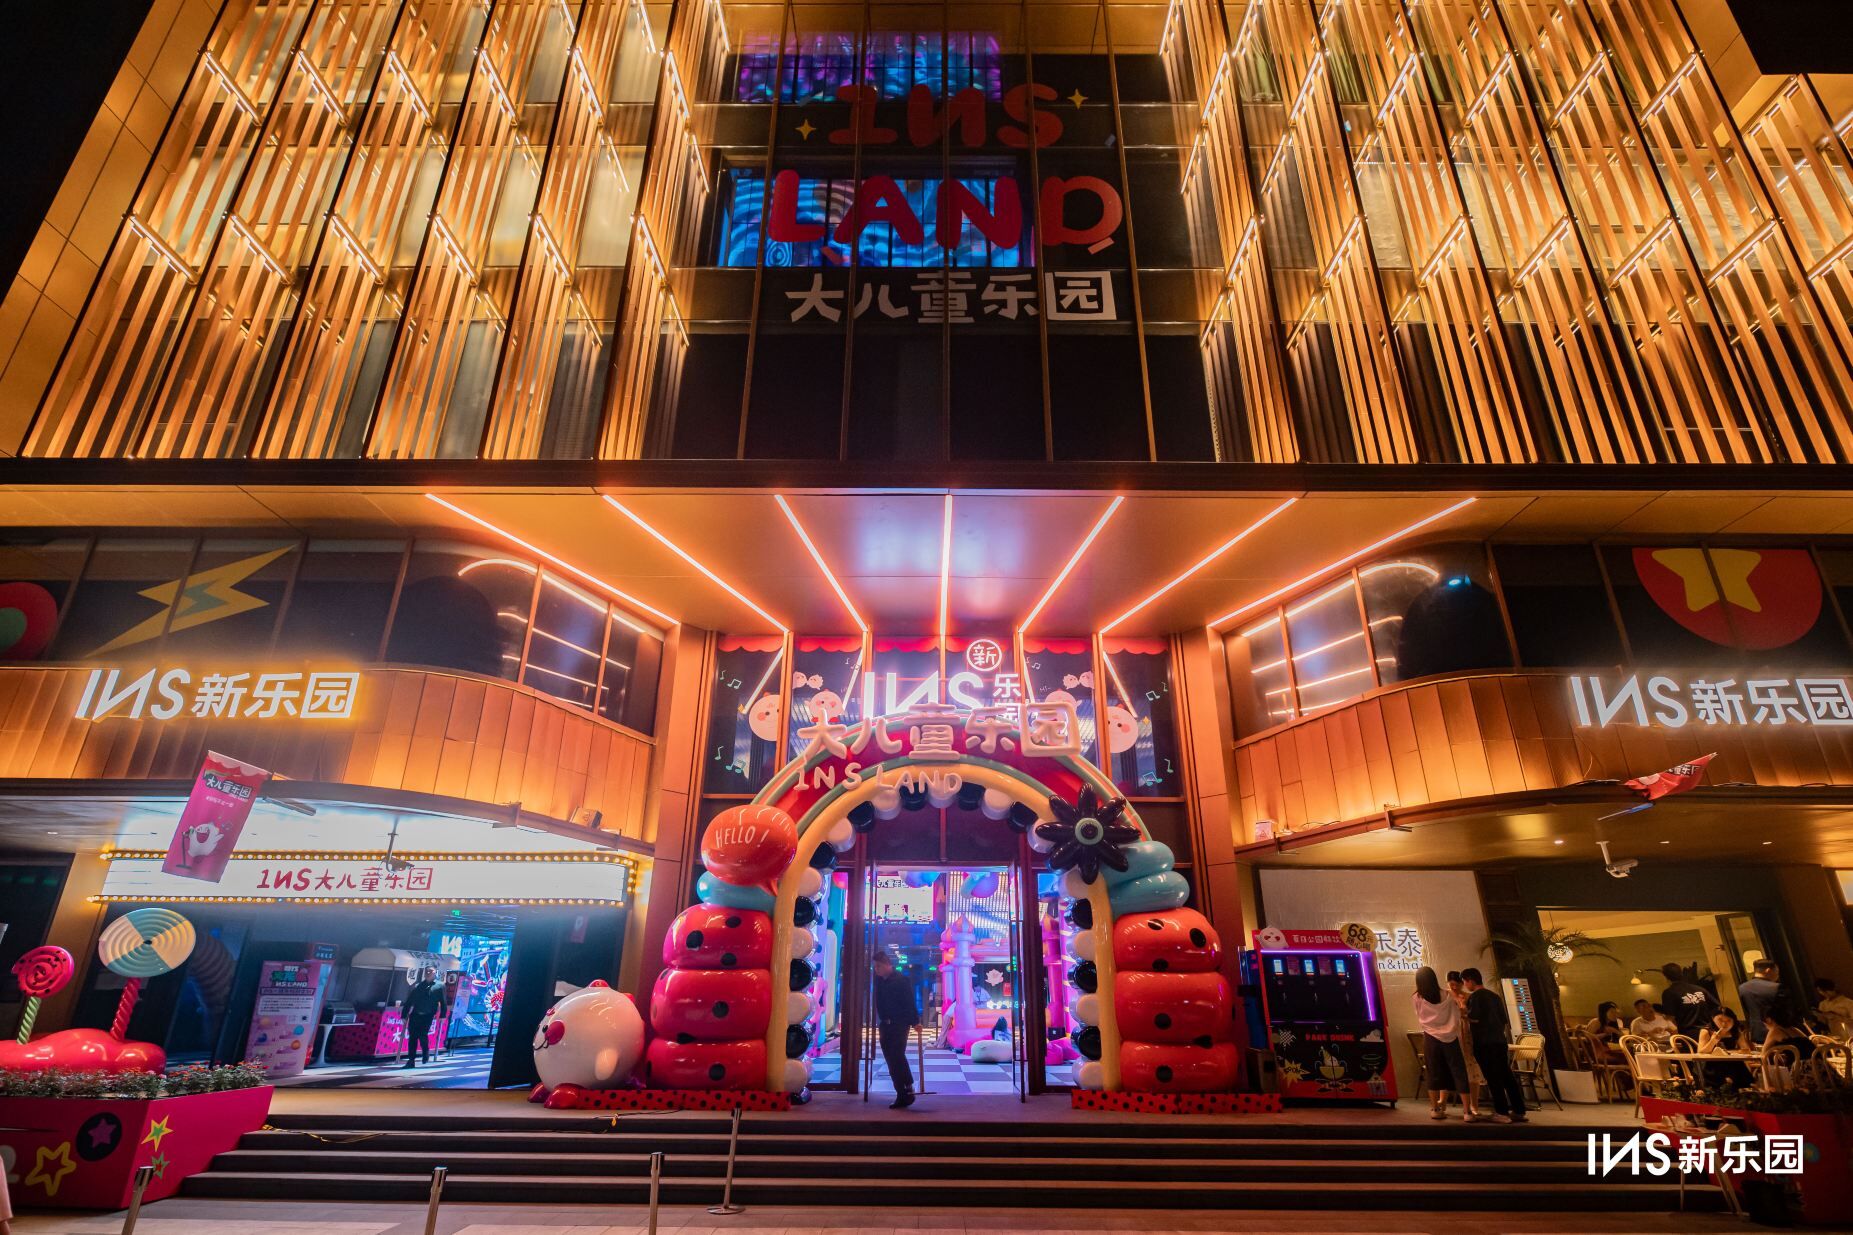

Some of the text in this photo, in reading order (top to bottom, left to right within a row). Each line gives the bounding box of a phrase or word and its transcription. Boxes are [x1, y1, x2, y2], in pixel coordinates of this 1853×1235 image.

[768, 168, 1124, 254] LAND
[785, 270, 1117, 323] 大儿童乐园
[797, 702, 1082, 760] 大儿童乐园
[206, 775, 252, 798] 大儿童乐园
[876, 764, 962, 794] LAND
